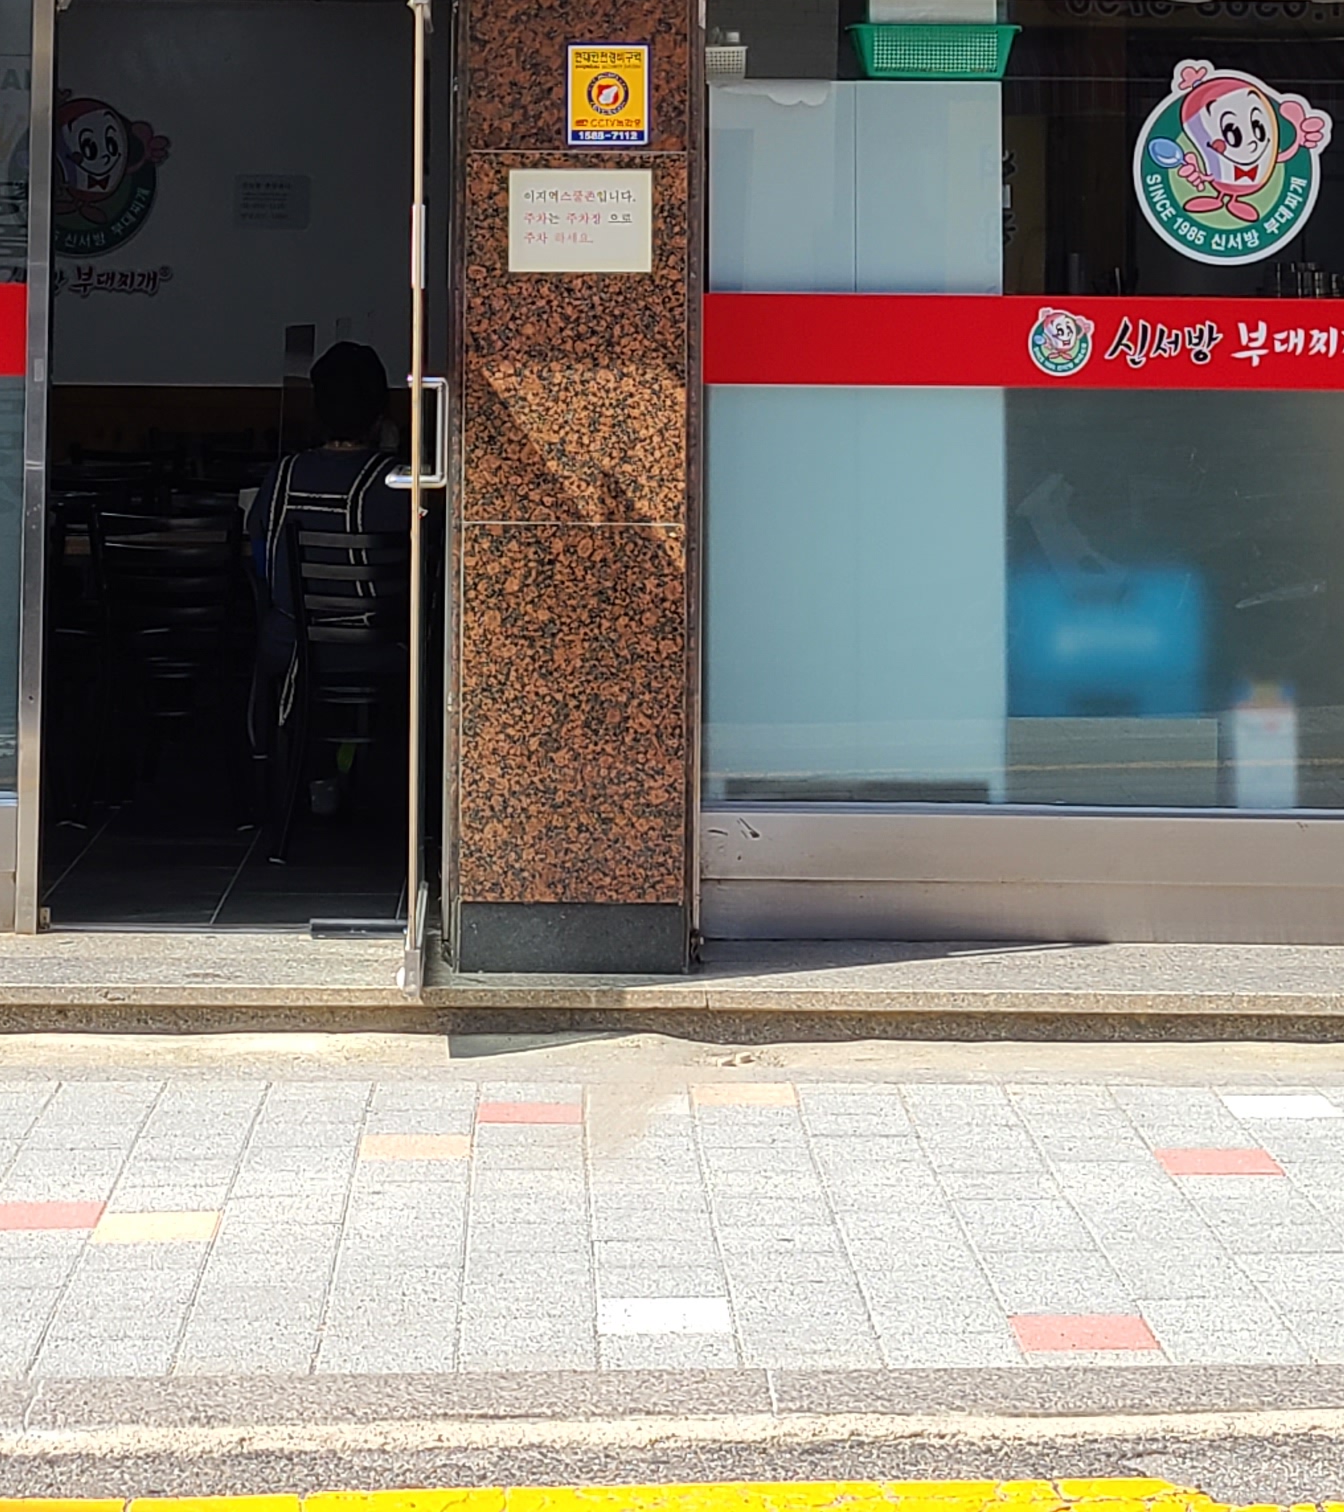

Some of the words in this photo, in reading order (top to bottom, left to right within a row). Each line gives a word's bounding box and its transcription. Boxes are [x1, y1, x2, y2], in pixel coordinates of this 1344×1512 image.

[1146, 174, 1177, 221] SINCE
[1172, 216, 1207, 245] 1985
[1211, 229, 1260, 251] 신서방
[1263, 176, 1309, 234] 부대찌개
[1104, 316, 1223, 368] 신서방
